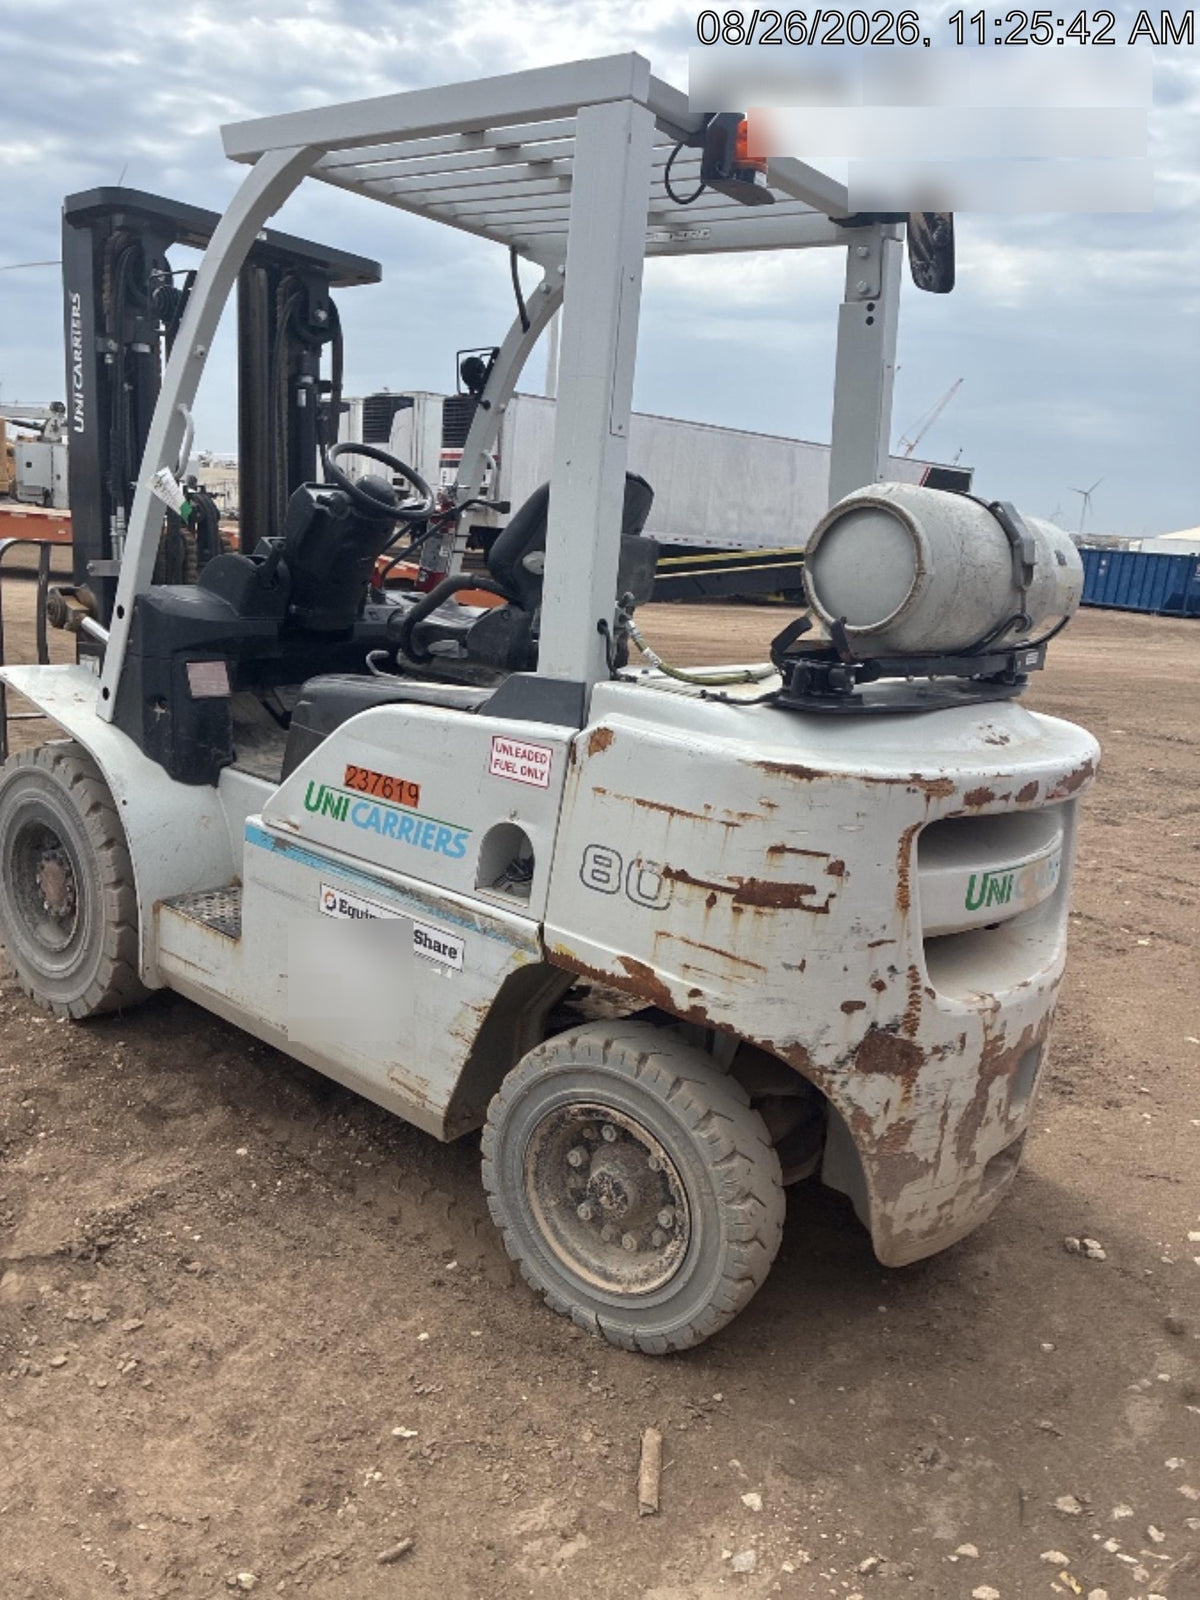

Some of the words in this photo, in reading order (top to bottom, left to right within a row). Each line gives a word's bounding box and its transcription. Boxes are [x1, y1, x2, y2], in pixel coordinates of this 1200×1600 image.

[495, 742, 547, 765] UNLEADED
[493, 758, 518, 774] FUEL
[520, 765, 546, 781] ONLY
[344, 765, 420, 807] 237619
[579, 843, 674, 911] 80
[413, 929, 458, 960] Share
